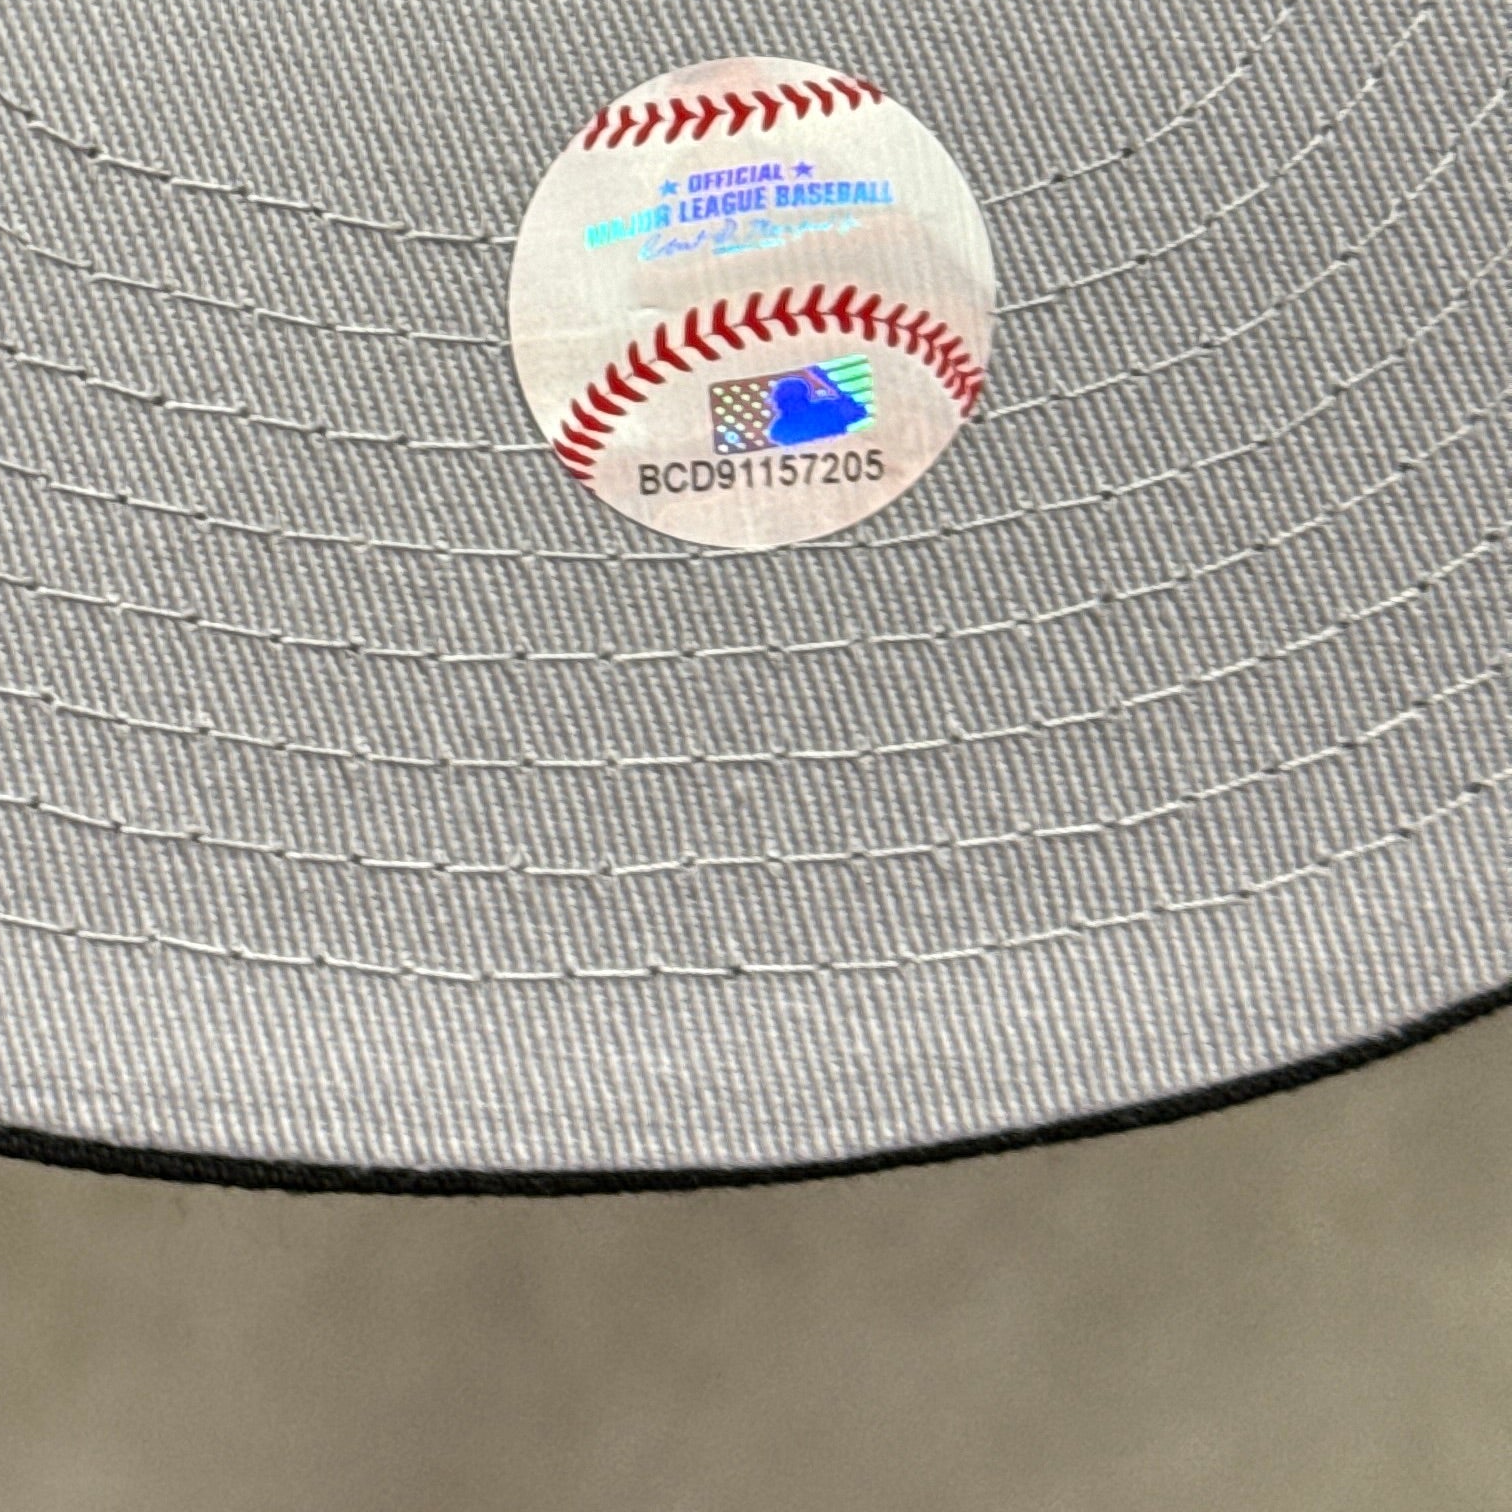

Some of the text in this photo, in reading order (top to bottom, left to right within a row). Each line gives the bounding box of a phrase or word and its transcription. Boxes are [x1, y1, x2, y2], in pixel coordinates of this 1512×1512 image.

[689, 164, 783, 192] OFFICIAL
[586, 204, 672, 249] MAJOR
[680, 186, 767, 223] LEAGUE
[775, 180, 892, 207] BASEBALL
[639, 449, 885, 495] BCD91157205
